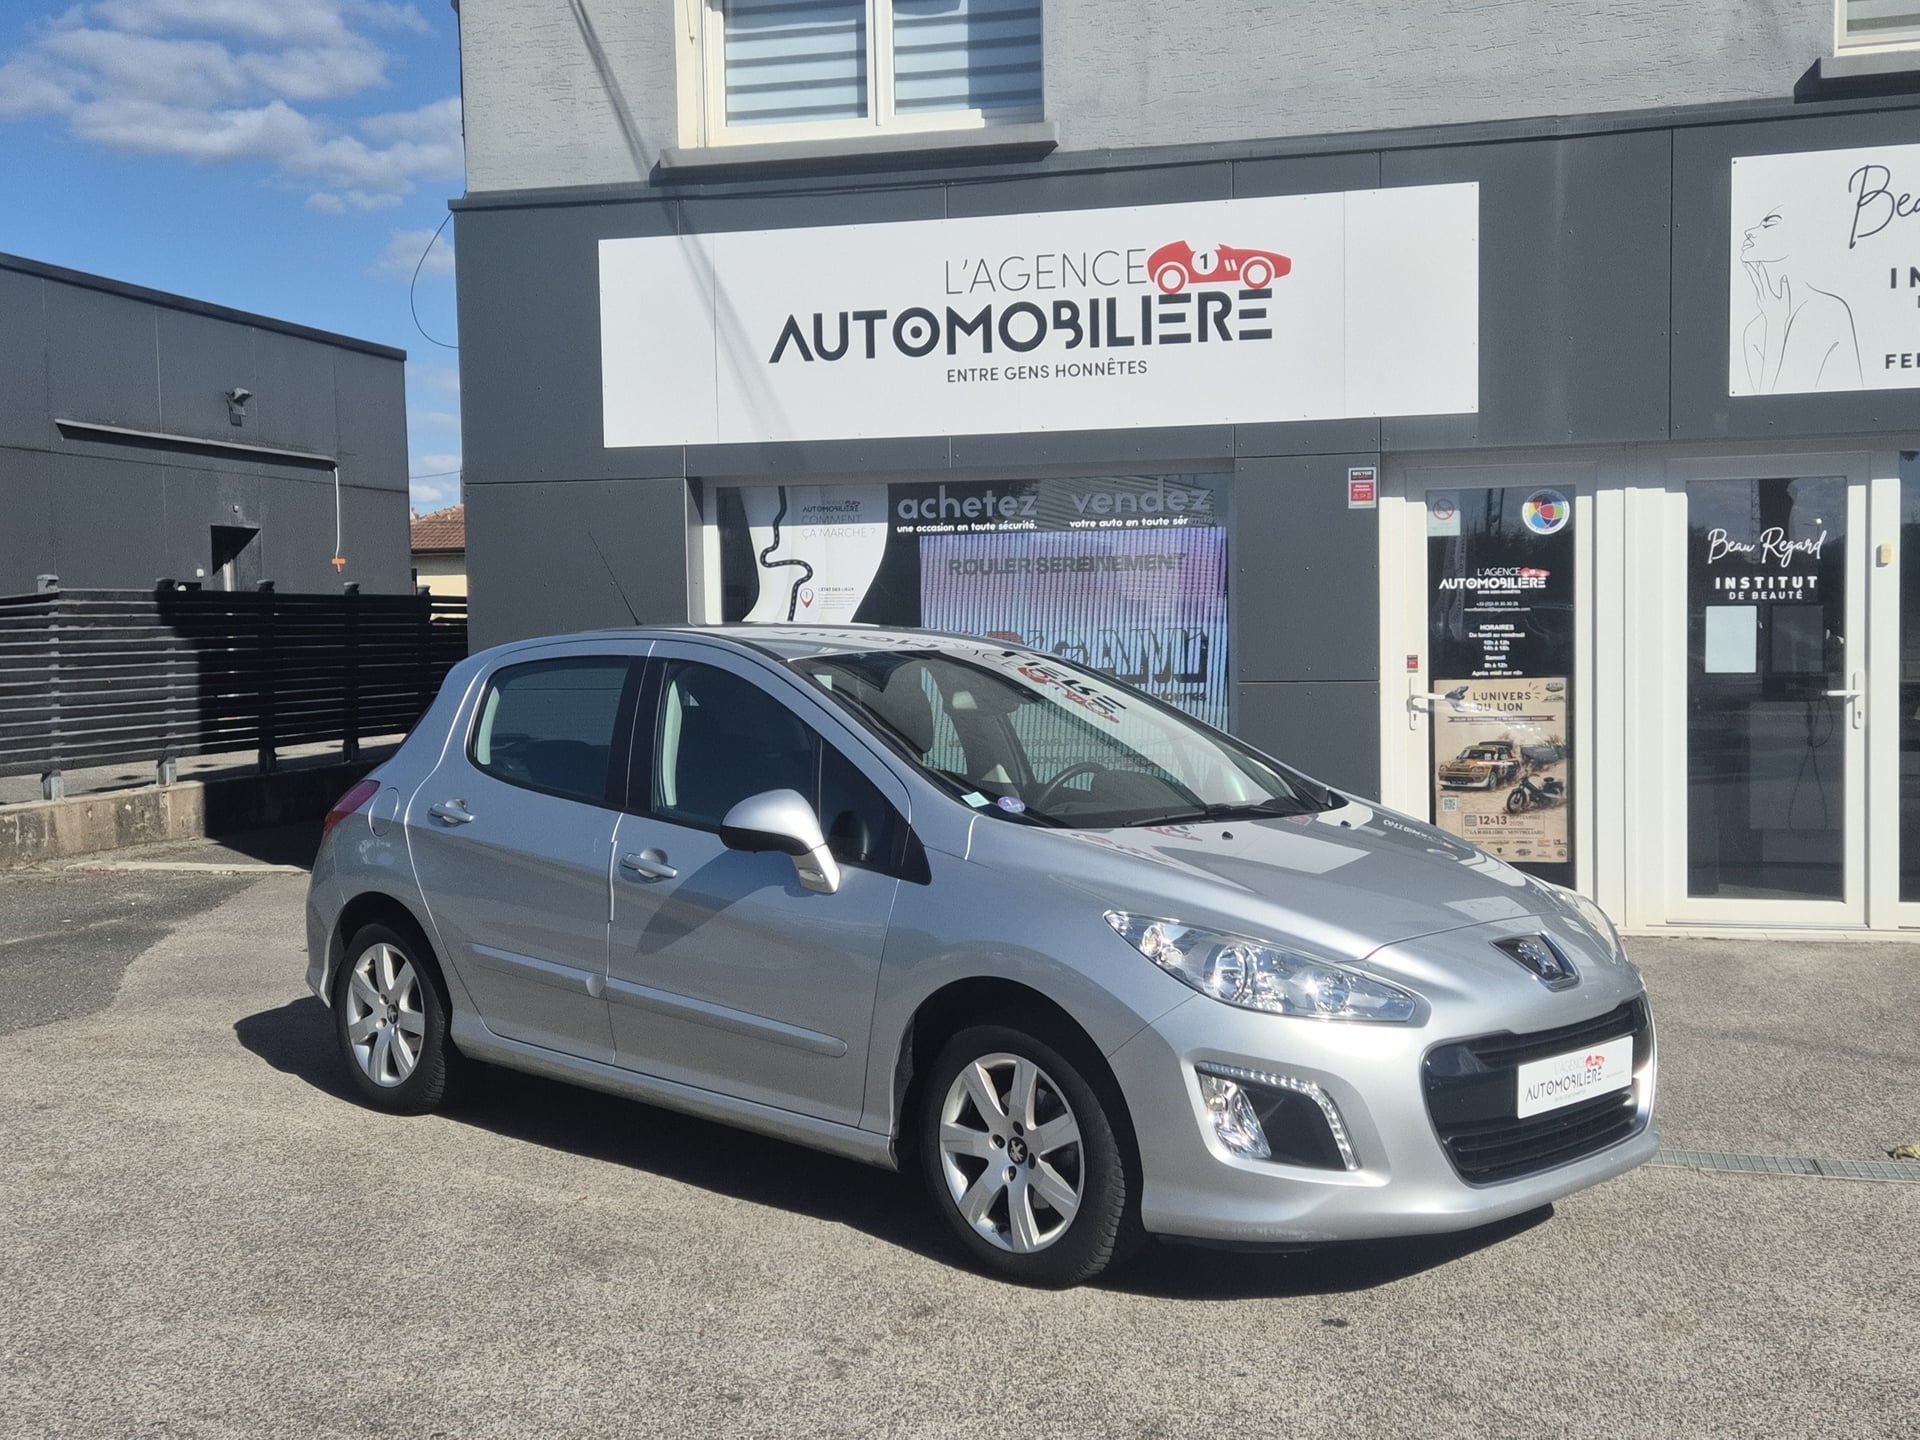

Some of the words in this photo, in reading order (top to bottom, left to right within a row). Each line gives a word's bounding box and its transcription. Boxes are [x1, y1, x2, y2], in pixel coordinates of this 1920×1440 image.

[946, 248, 1147, 295] L'AGENCE
[1885, 353, 1920, 369] FE
[947, 367, 999, 383] ENTRE
[1004, 365, 1050, 380] GENS
[1055, 357, 1148, 378] HONNÊTES
[1070, 476, 1212, 514] vendez
[897, 485, 1038, 519] achetez
[801, 514, 863, 524] COMMENT
[1069, 520, 1096, 528] votre
[1099, 518, 1123, 527] auto
[1126, 519, 1139, 527] en
[1141, 517, 1170, 526] toute
[897, 525, 914, 533] une
[916, 523, 954, 533] occasion
[971, 523, 996, 531] toute
[998, 520, 1038, 531] sécurité.
[801, 528, 817, 540] ÇA
[820, 527, 866, 538] MARCHE
[1708, 528, 1755, 564] Beau
[1760, 527, 1827, 568] Regard
[949, 558, 1031, 576] ROULER
[1477, 567, 1520, 576] L'AGENCE
[1715, 576, 1817, 589] INSTITUT
[1729, 591, 1744, 600] DE
[1752, 589, 1803, 600] BEAUTÉ
[1497, 703, 1523, 711] LION
